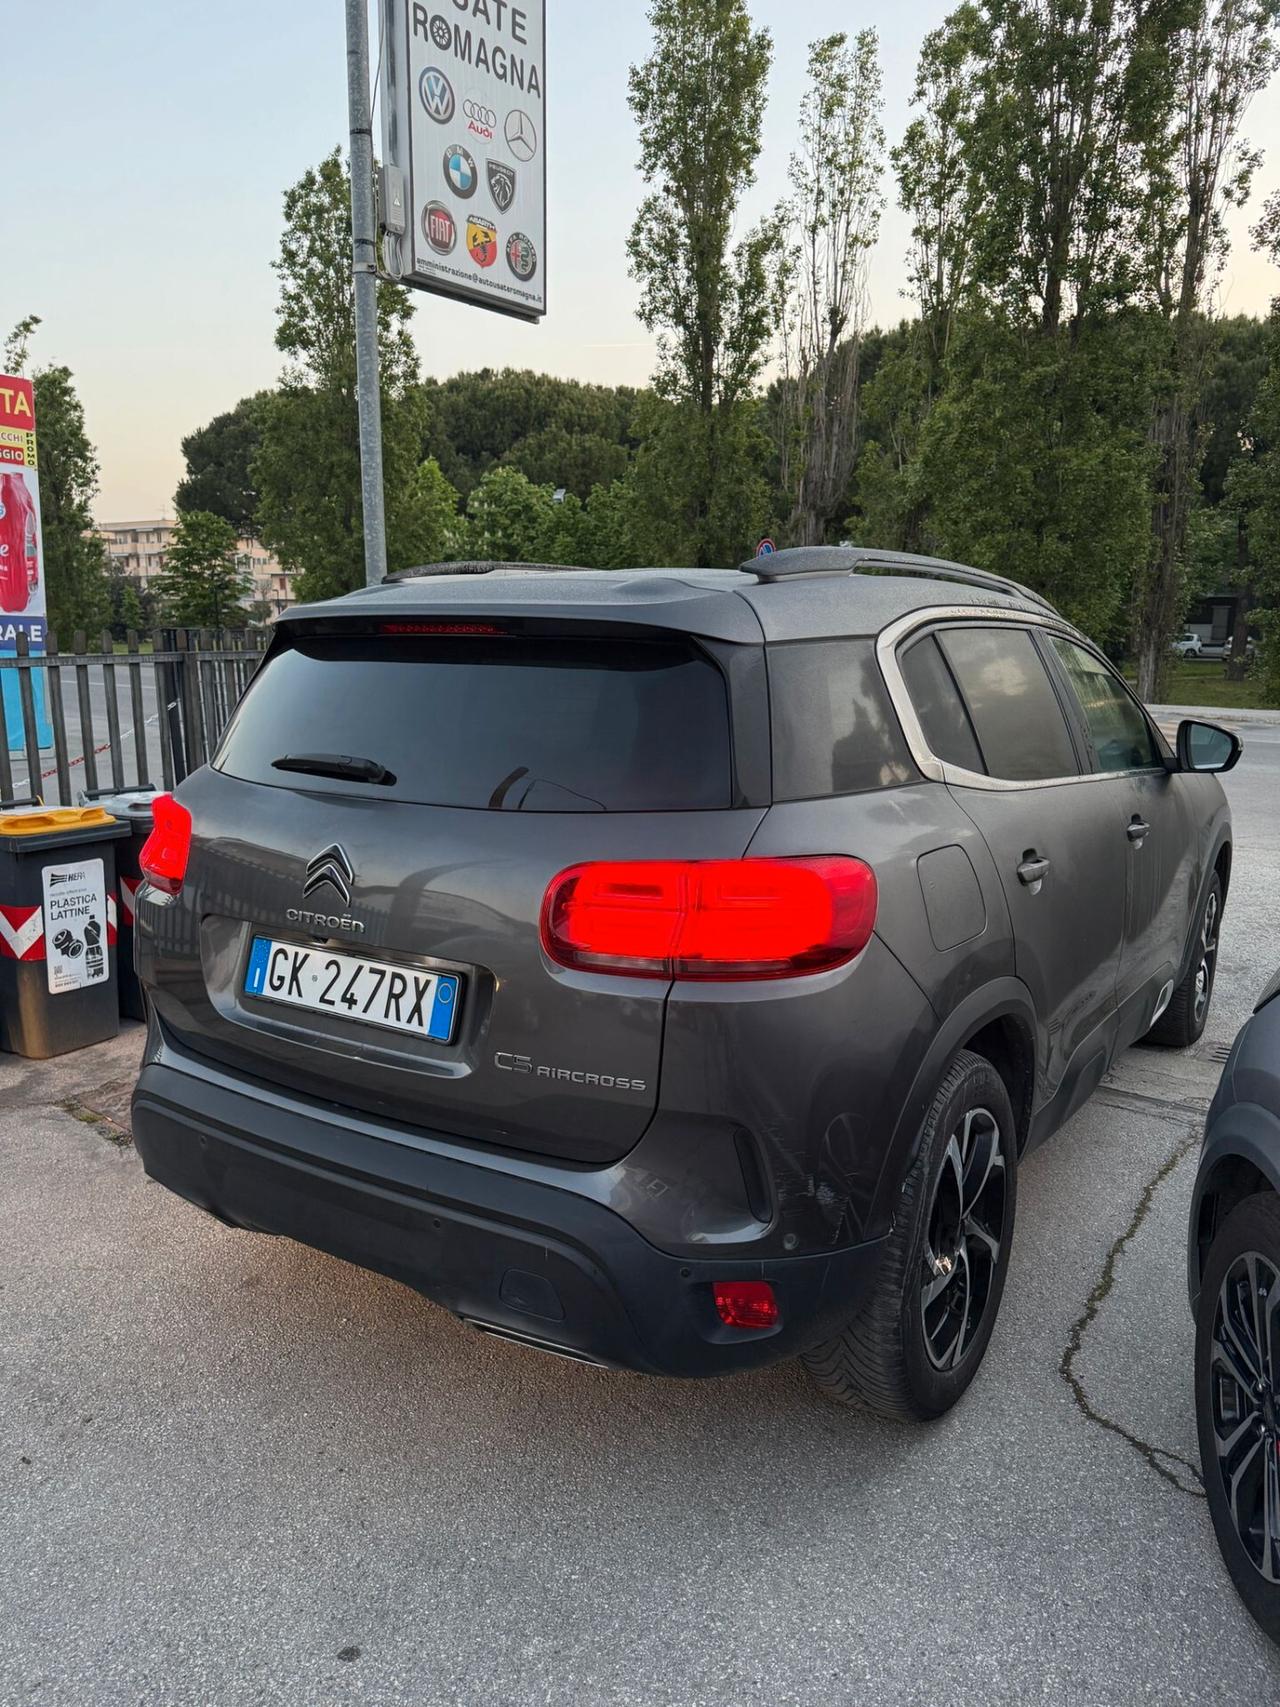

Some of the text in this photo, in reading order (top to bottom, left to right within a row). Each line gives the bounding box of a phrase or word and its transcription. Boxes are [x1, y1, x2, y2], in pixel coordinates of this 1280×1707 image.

[413, 2, 541, 99] ROMAGNA
[430, 214, 451, 243] FIAT
[416, 257, 542, 303] amministrazione@autousateromagna.it
[0, 448, 24, 461] GIO
[26, 432, 35, 466] PROMO
[50, 893, 97, 909] PLASTICA
[50, 905, 91, 920] LATTINE
[494, 1052, 647, 1091] C5 AIRCROSS
